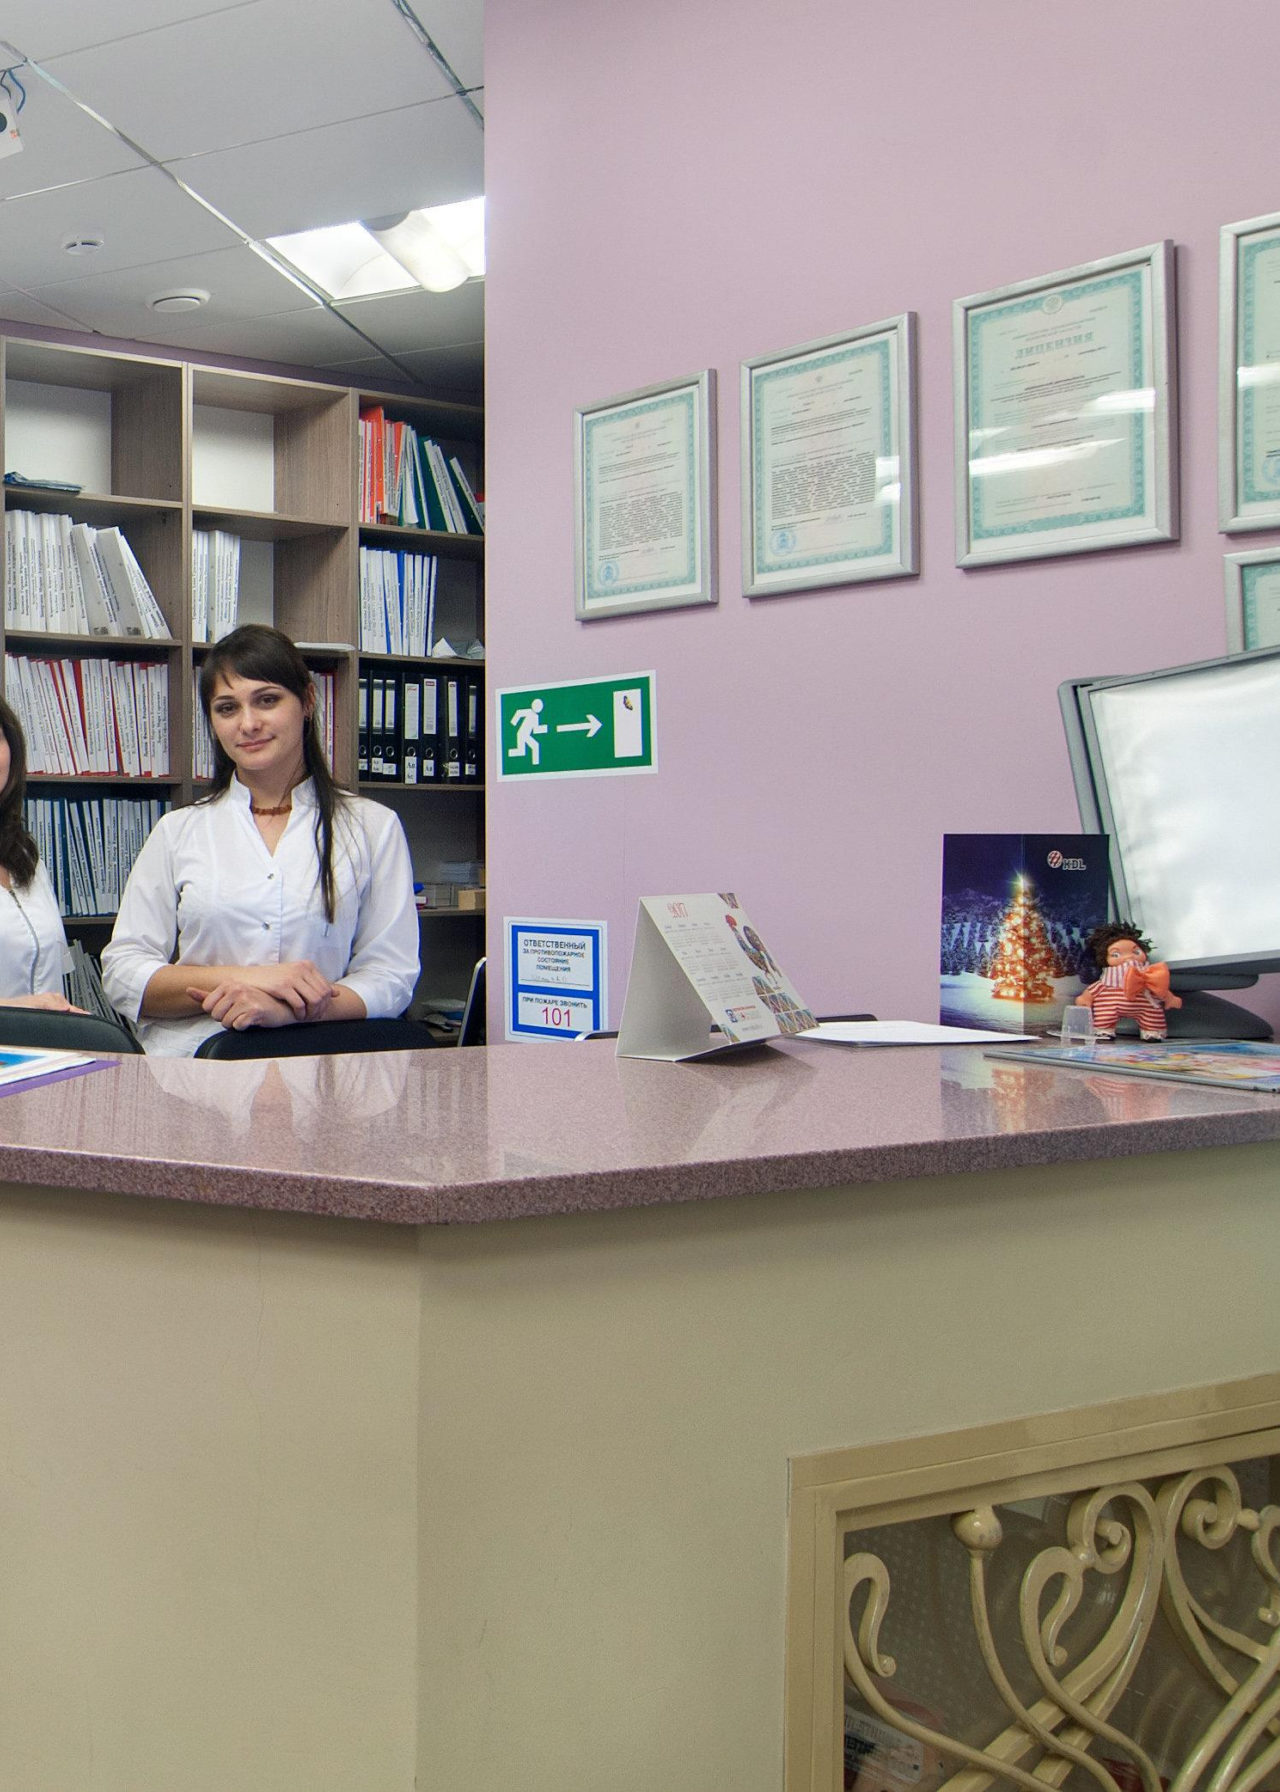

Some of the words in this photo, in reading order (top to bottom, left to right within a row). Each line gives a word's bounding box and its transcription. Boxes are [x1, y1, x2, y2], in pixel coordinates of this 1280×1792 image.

[1063, 858, 1087, 870] KDL
[523, 939, 586, 950] ОТВЕТСТВЕННЫЙ
[530, 948, 585, 959] ПРОТИВОПОЖАРНОЕ
[537, 957, 569, 965] СОСТОЯНИЕ
[536, 964, 571, 972] ПОМЕЩЕНИЯ
[560, 1000, 587, 1008] ЗВОНИТЬ
[542, 1007, 571, 1027] 101
